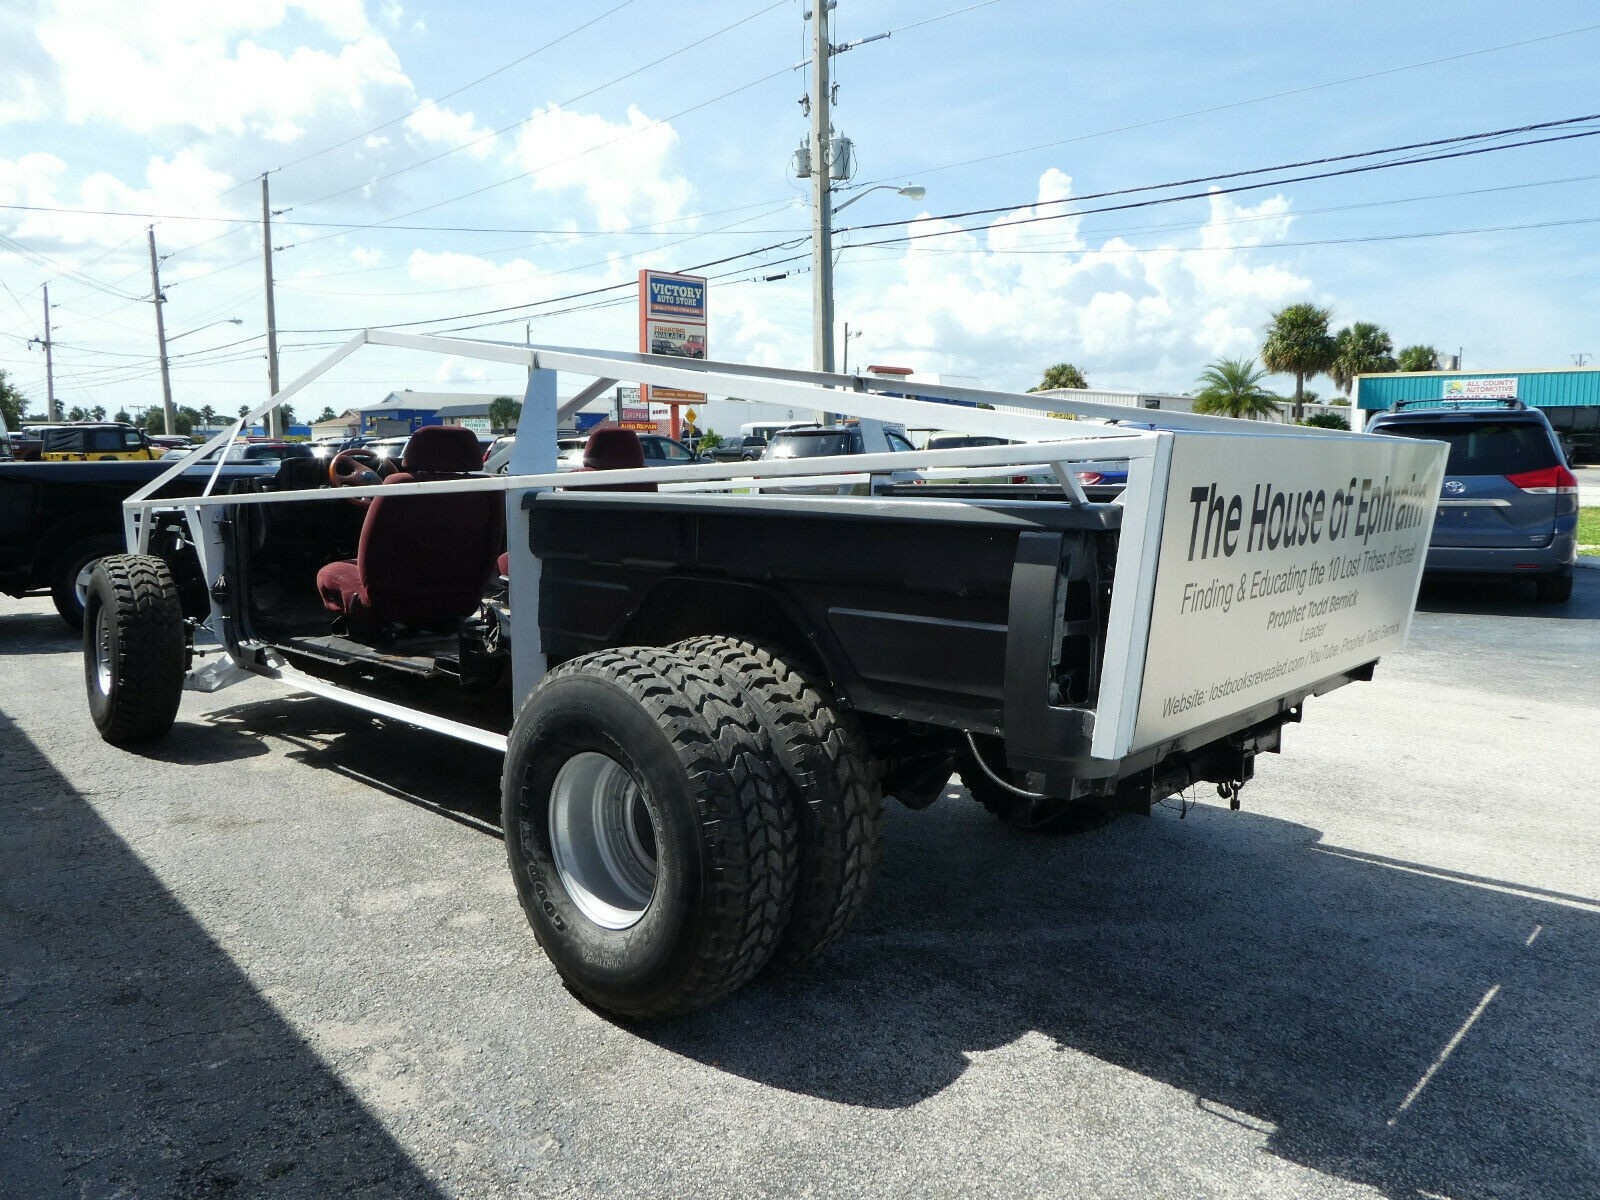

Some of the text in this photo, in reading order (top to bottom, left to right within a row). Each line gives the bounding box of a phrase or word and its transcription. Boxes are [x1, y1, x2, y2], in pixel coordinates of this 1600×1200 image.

[651, 283, 702, 299] VICTORY
[657, 295, 697, 306] AUTO STORE
[654, 332, 686, 340] AVAILABLE
[623, 411, 648, 419] EUROPEAN
[1187, 473, 1428, 561] The House of Ephraim
[1180, 541, 1417, 614] Finding & Educating the 10 Lost Tribes of Israel
[1267, 588, 1359, 630] Prophet Todd Bernick
[1298, 621, 1327, 643] Leader
[1162, 688, 1208, 718] Website:
[1208, 655, 1305, 702] lostbooksrevealed.com
[1341, 631, 1366, 652] Prophet
[1366, 626, 1381, 645] Todd
